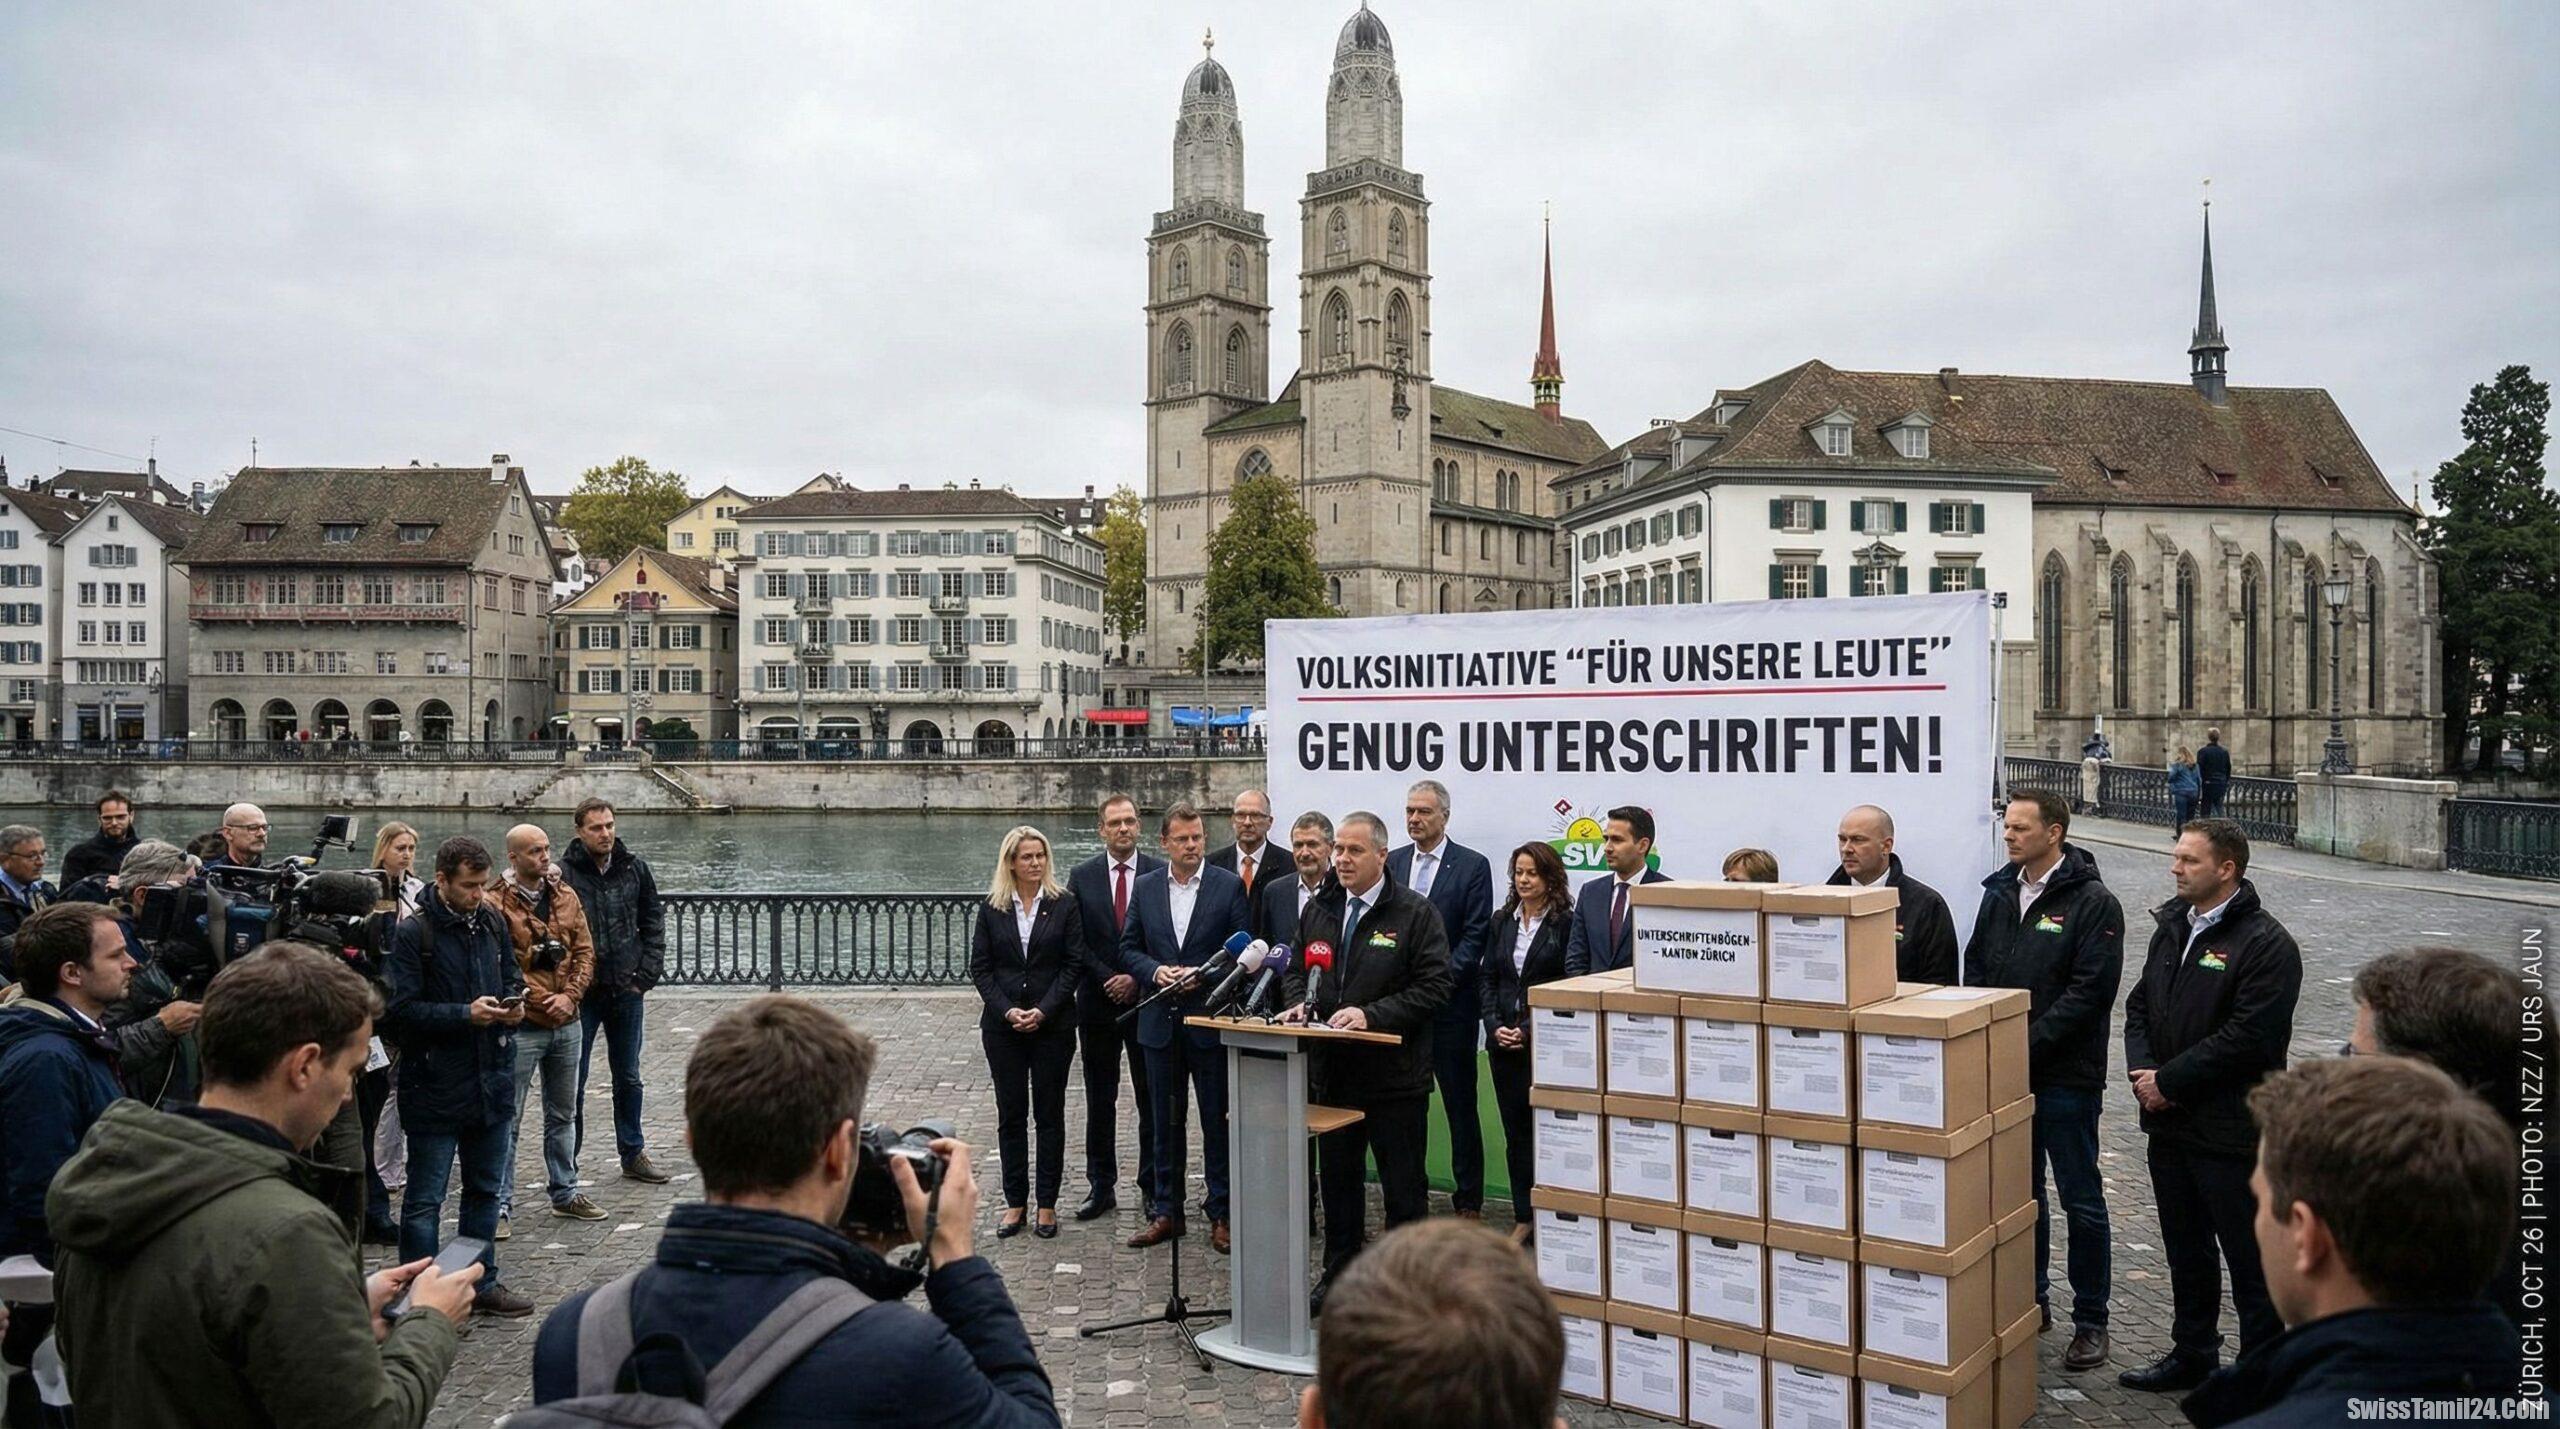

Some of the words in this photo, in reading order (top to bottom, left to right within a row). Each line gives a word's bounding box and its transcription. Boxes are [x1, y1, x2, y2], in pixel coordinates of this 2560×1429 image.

[1296, 650, 1556, 689] VOLKSINITIATIVE
[1566, 639, 1652, 684] “FÜR
[1663, 641, 1802, 683] UNSERE
[1814, 636, 1951, 679] LEUTE”
[1298, 721, 1444, 772] GENUG
[1460, 716, 1942, 773] UNTERSCHRIFTEN!
[1562, 842, 1606, 867] SV
[1661, 947, 1699, 960] KANTON
[1700, 948, 1736, 962] ZÜRICH
